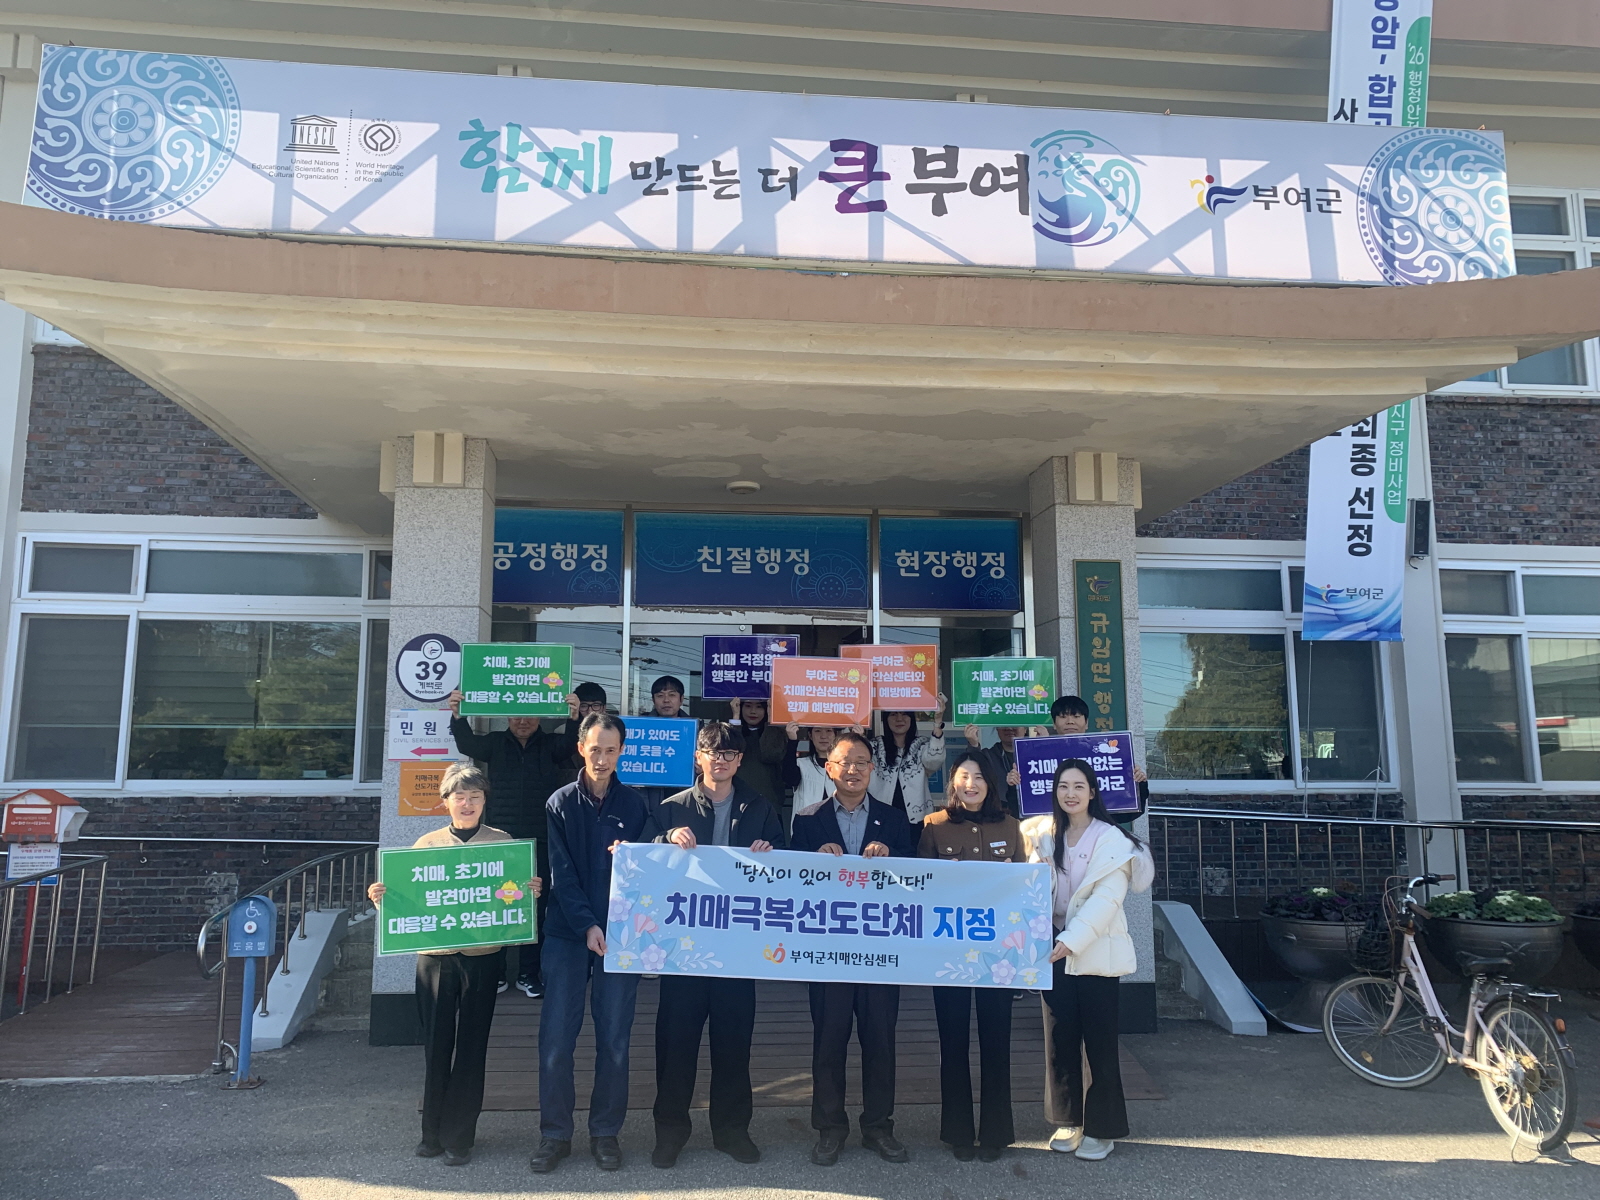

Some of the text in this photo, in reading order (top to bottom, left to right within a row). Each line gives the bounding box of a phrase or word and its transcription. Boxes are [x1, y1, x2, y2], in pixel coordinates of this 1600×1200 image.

[292, 124, 335, 146] UNESCO
[251, 163, 293, 172] Educational,
[294, 165, 329, 173] Scientific
[314, 159, 340, 167] Nations
[376, 163, 405, 171] Heritage
[458, 118, 1030, 217] 함께 만드는 더 큰 부여
[268, 171, 339, 181] Cultural Organization
[1251, 184, 1343, 214] 부여군
[1387, 441, 1404, 505] 정비사업
[1346, 486, 1375, 557] 선정
[492, 541, 609, 573] 공정행정
[696, 545, 811, 577] 친절행정
[894, 548, 1007, 579] 현장행정
[1346, 587, 1384, 600] 부여군
[1090, 612, 1112, 683] 규암면
[482, 656, 550, 669] 치매, 초기에
[711, 653, 736, 666] 치매
[872, 655, 904, 666] 부여군
[415, 661, 447, 681] 39
[711, 670, 748, 683] 행복한
[805, 669, 838, 682] 부여군
[971, 670, 1034, 682] 치매, 초기에
[417, 681, 443, 690] 계백로
[492, 673, 541, 687] 발견하면
[465, 691, 566, 704] 대응할 수 있습니다.
[783, 684, 859, 699] 치매안심센터와
[879, 687, 922, 698] 예방해요
[980, 687, 1026, 699] 발견하면
[787, 701, 855, 715] 함께 예방해요
[957, 703, 1052, 715] 대응할 수 있습니다.
[648, 729, 680, 741] 있어도
[640, 745, 662, 757] 웃을
[664, 746, 676, 757] 수
[621, 761, 668, 773] 있습니다.
[1027, 759, 1058, 775] 치매
[414, 783, 439, 791] 선도기관
[411, 860, 504, 883] 치매, 초기에
[735, 861, 933, 891] "당신이 있어 행복합니다!"
[425, 886, 491, 907] 발견하면
[388, 908, 527, 935] 대응할 수 있습니다.
[664, 891, 997, 942] 치매극복선도단체 지정
[790, 950, 899, 967] 부여군치매안심센터
